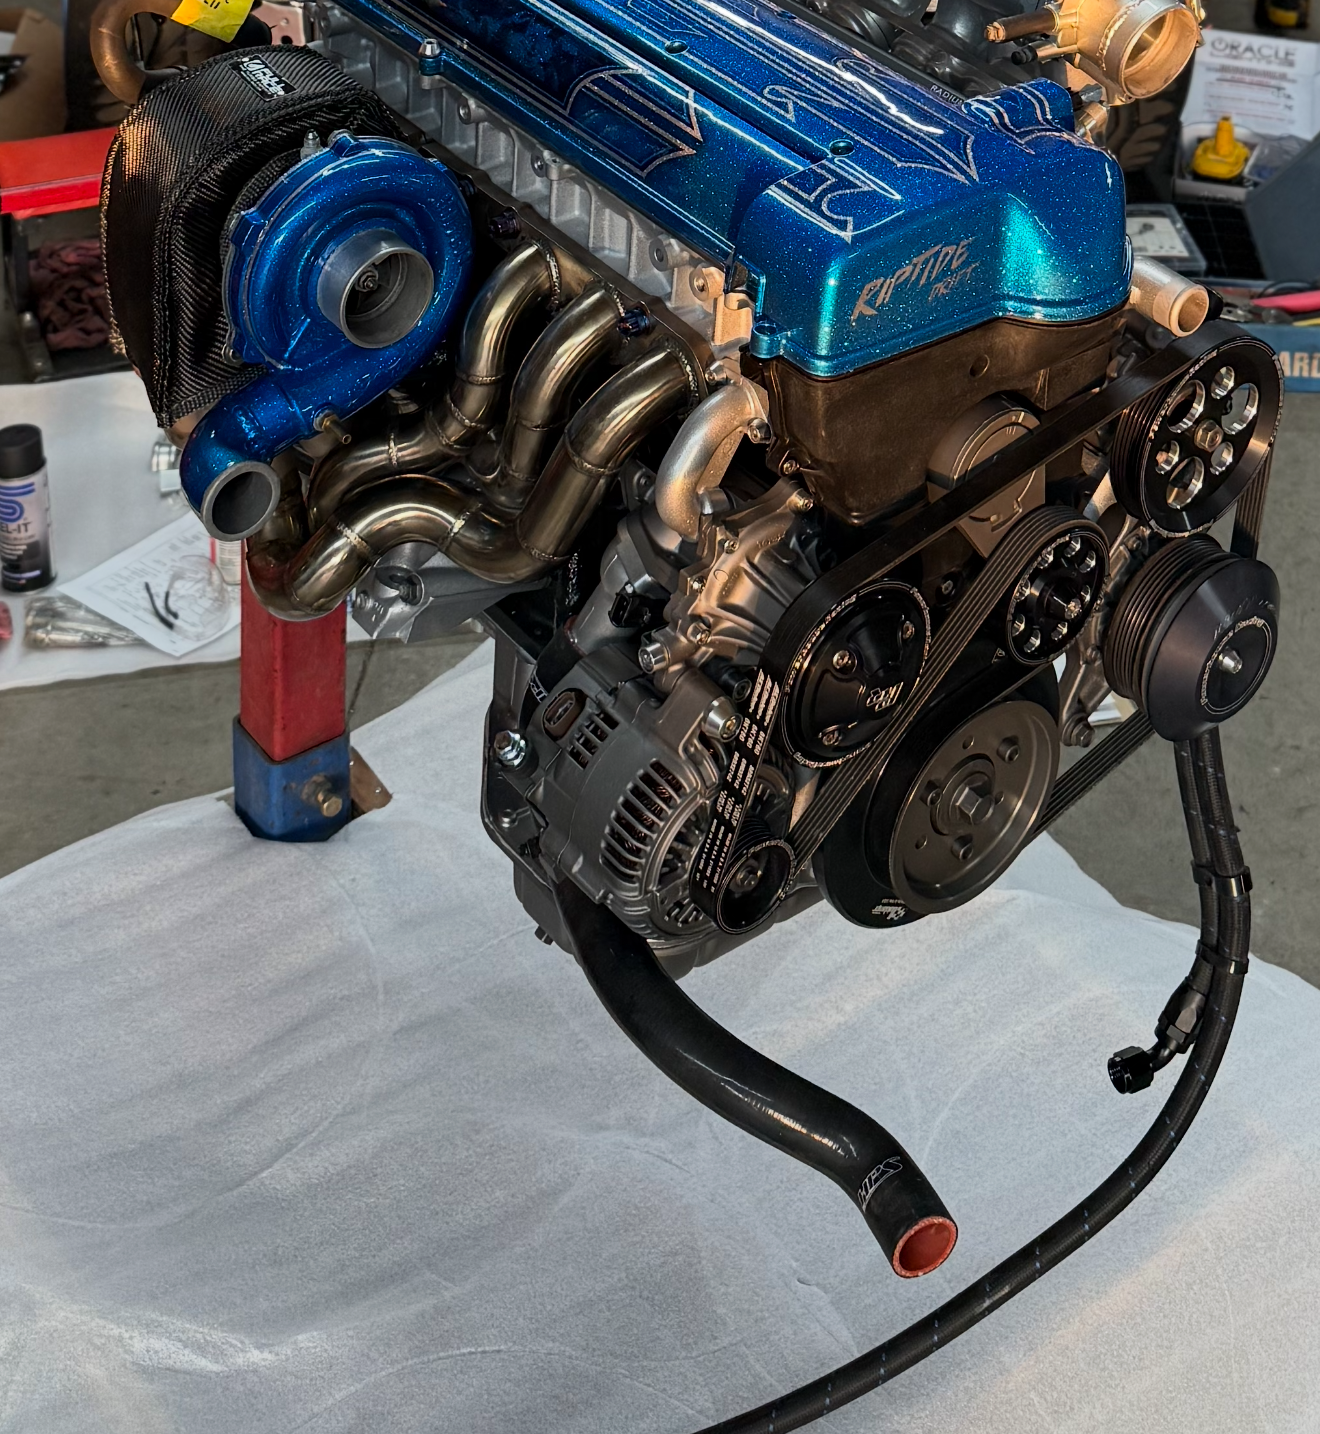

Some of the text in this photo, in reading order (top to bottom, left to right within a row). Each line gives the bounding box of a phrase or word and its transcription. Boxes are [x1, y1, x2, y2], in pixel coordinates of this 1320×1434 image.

[1210, 36, 1297, 61] ORACLE
[850, 236, 976, 325] RIPTIDE
[857, 1156, 904, 1214] HPS
